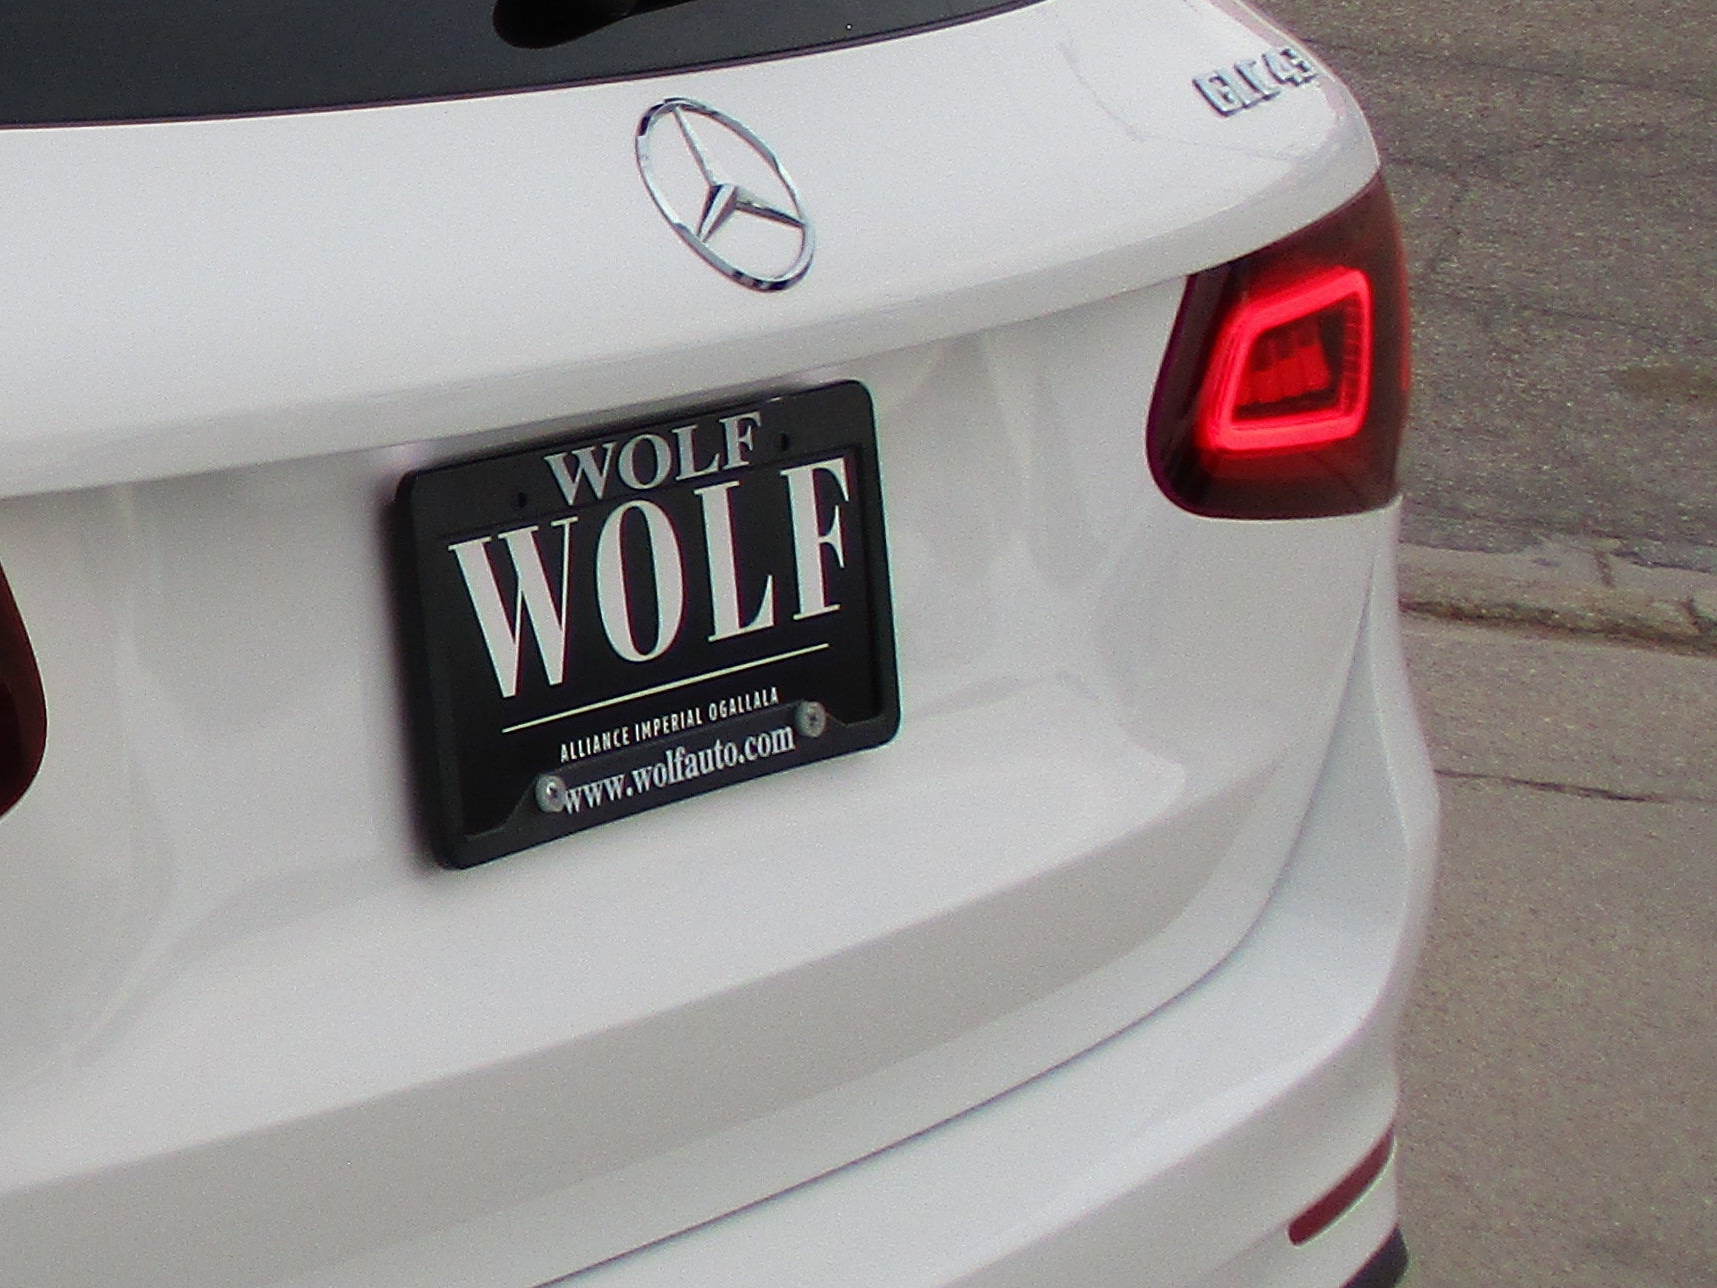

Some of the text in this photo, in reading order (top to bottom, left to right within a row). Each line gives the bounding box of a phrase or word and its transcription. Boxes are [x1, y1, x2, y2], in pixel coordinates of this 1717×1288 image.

[543, 411, 762, 506] WOLF
[447, 457, 851, 698] WOLF
[559, 687, 780, 763] ALLIANCE IMPERIAL OGALLALA
[563, 725, 796, 814] www.wolfauto.com
